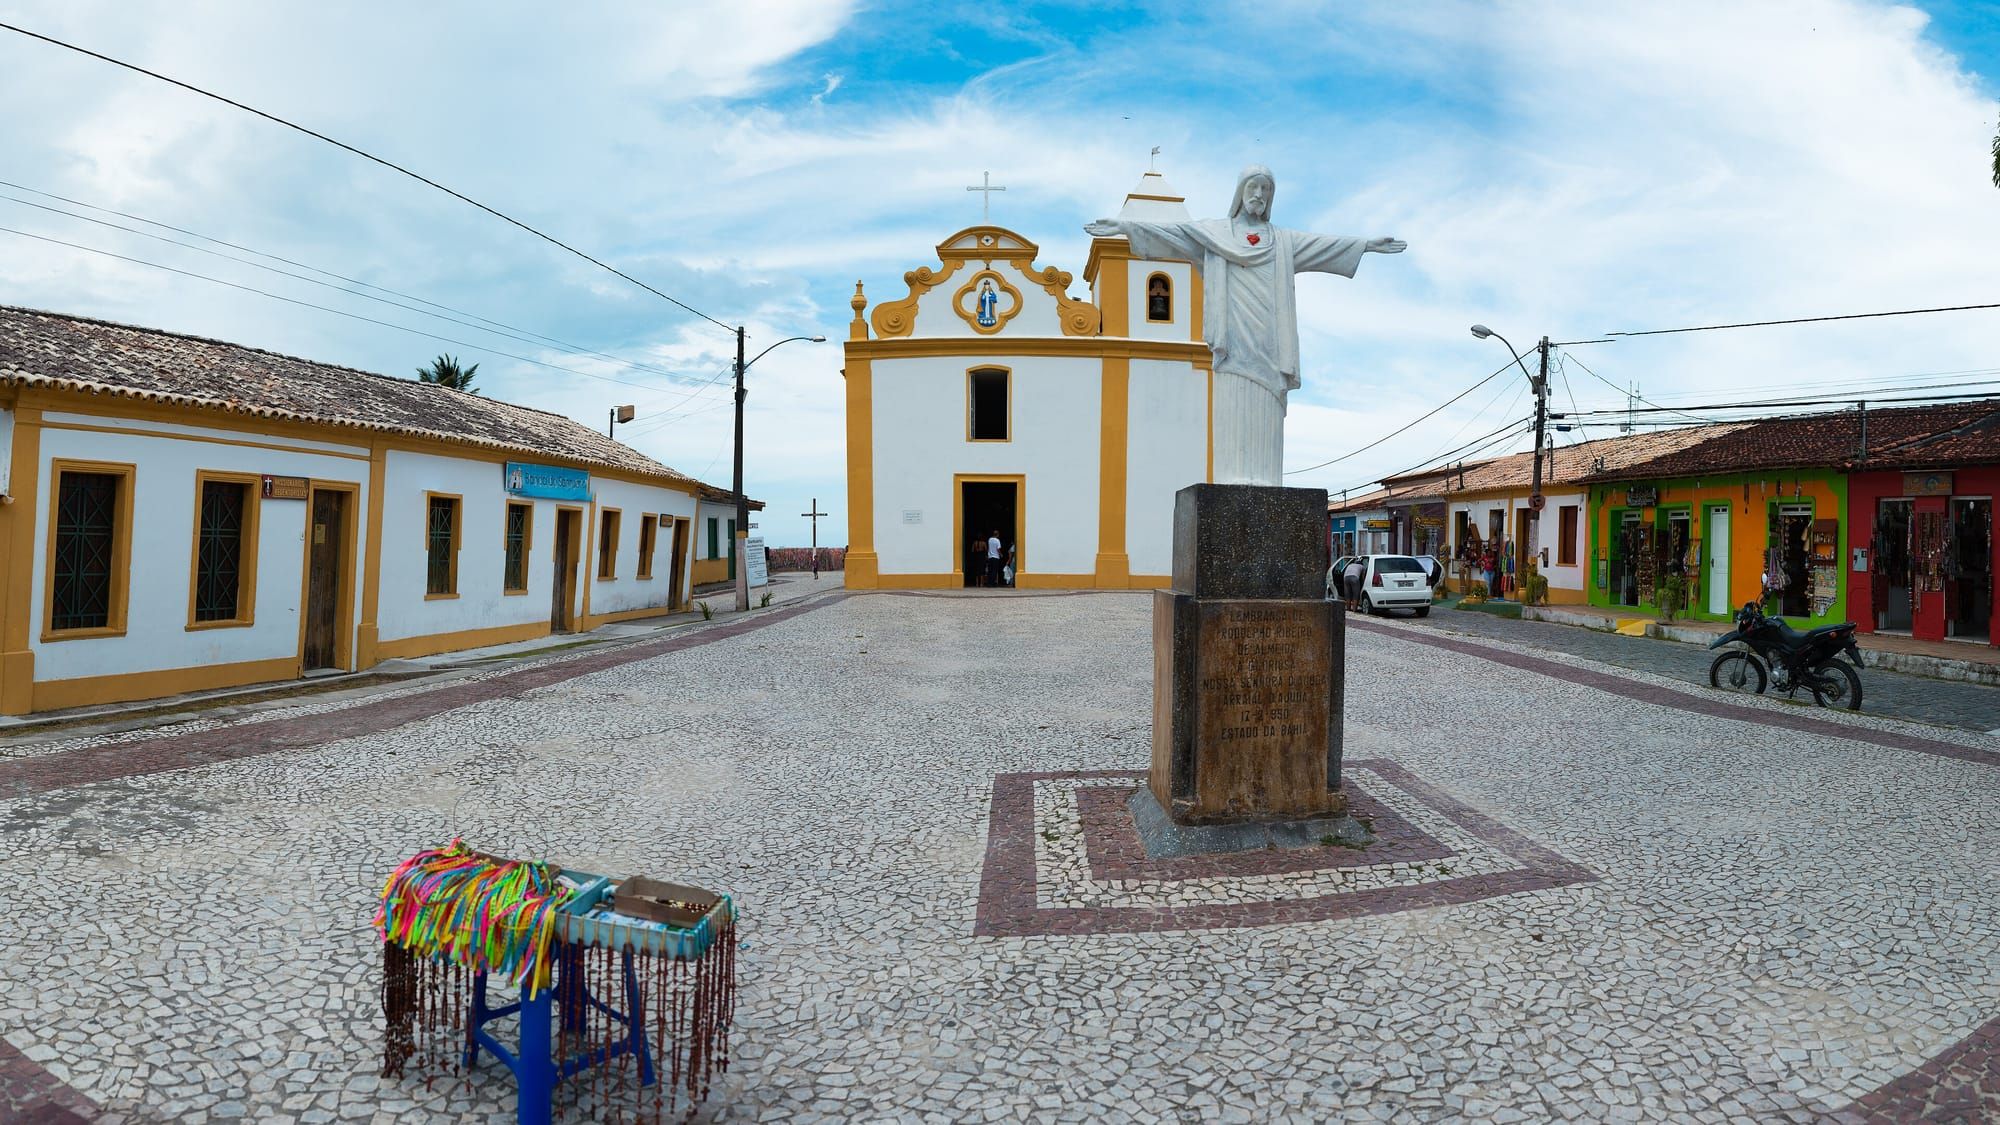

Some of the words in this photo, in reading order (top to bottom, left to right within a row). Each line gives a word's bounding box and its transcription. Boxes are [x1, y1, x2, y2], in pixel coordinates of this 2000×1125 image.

[1276, 625, 1312, 638] RIBEIRO
[1237, 643, 1249, 656] DE
[1203, 677, 1235, 690] NOSSA
[1240, 675, 1283, 689] SENHORA
[1223, 692, 1262, 705] ARRAIAL
[1221, 726, 1258, 740] ESTADO
[1263, 725, 1275, 737] DA
[1281, 723, 1307, 737] BAHIA
